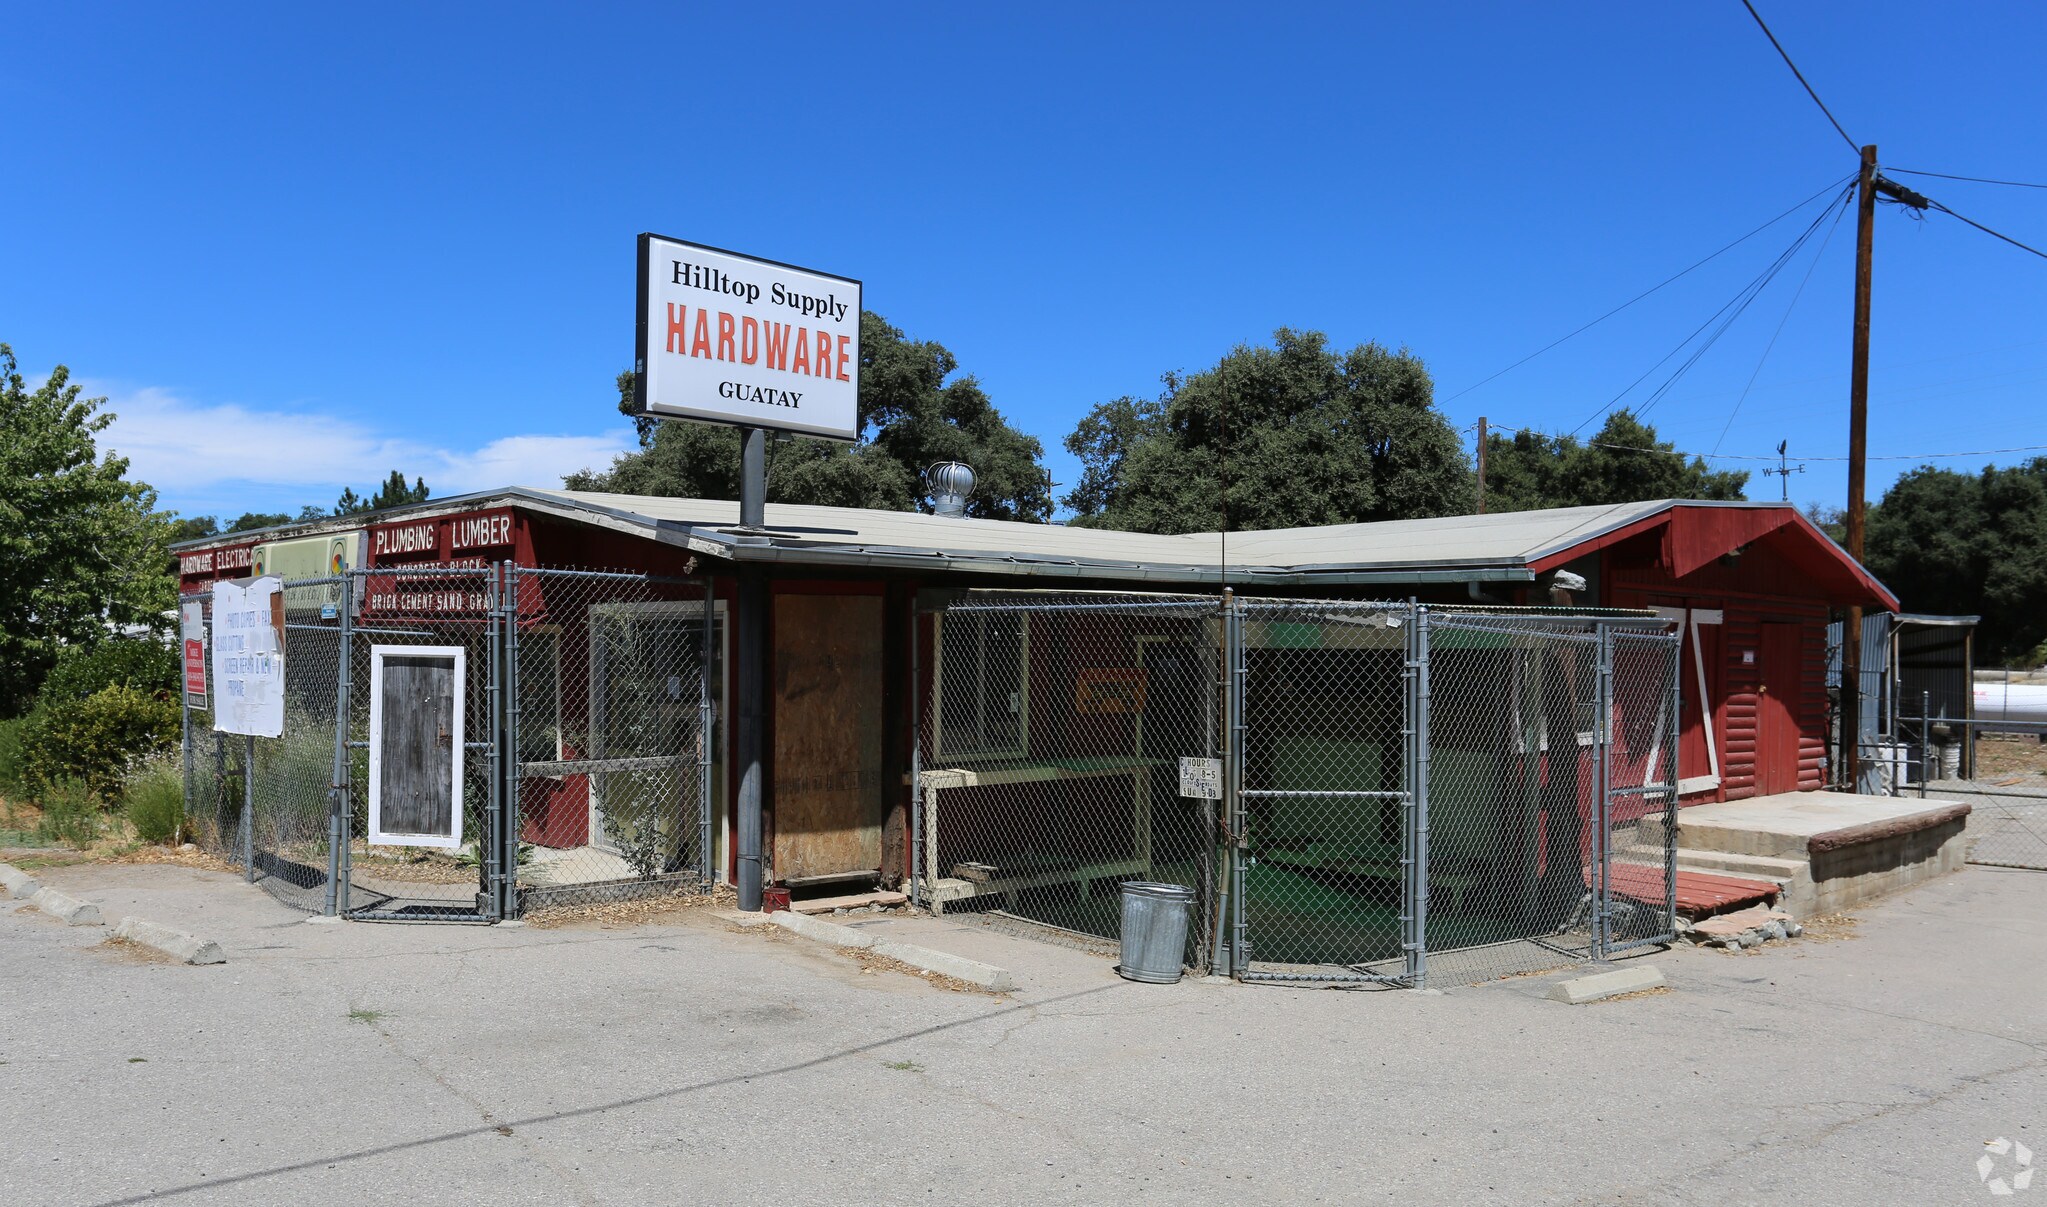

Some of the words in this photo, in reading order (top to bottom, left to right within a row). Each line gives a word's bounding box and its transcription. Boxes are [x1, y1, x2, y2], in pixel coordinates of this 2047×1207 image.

[671, 260, 760, 304] Hilltop
[771, 282, 848, 322] Supply
[666, 302, 850, 382] HARDWARE
[718, 381, 803, 409] GUATAY
[376, 524, 434, 554] PLUMBING
[452, 514, 510, 548] LUMBER
[180, 553, 213, 575] HARDWARE
[396, 562, 441, 580] CONCRETE
[372, 594, 397, 610] BRICK
[401, 594, 433, 610] CEMENT
[437, 593, 462, 610] SAND
[469, 593, 506, 610] GRAVL
[1187, 758, 1211, 768] HOURS
[1201, 769, 1216, 779] 8-5
